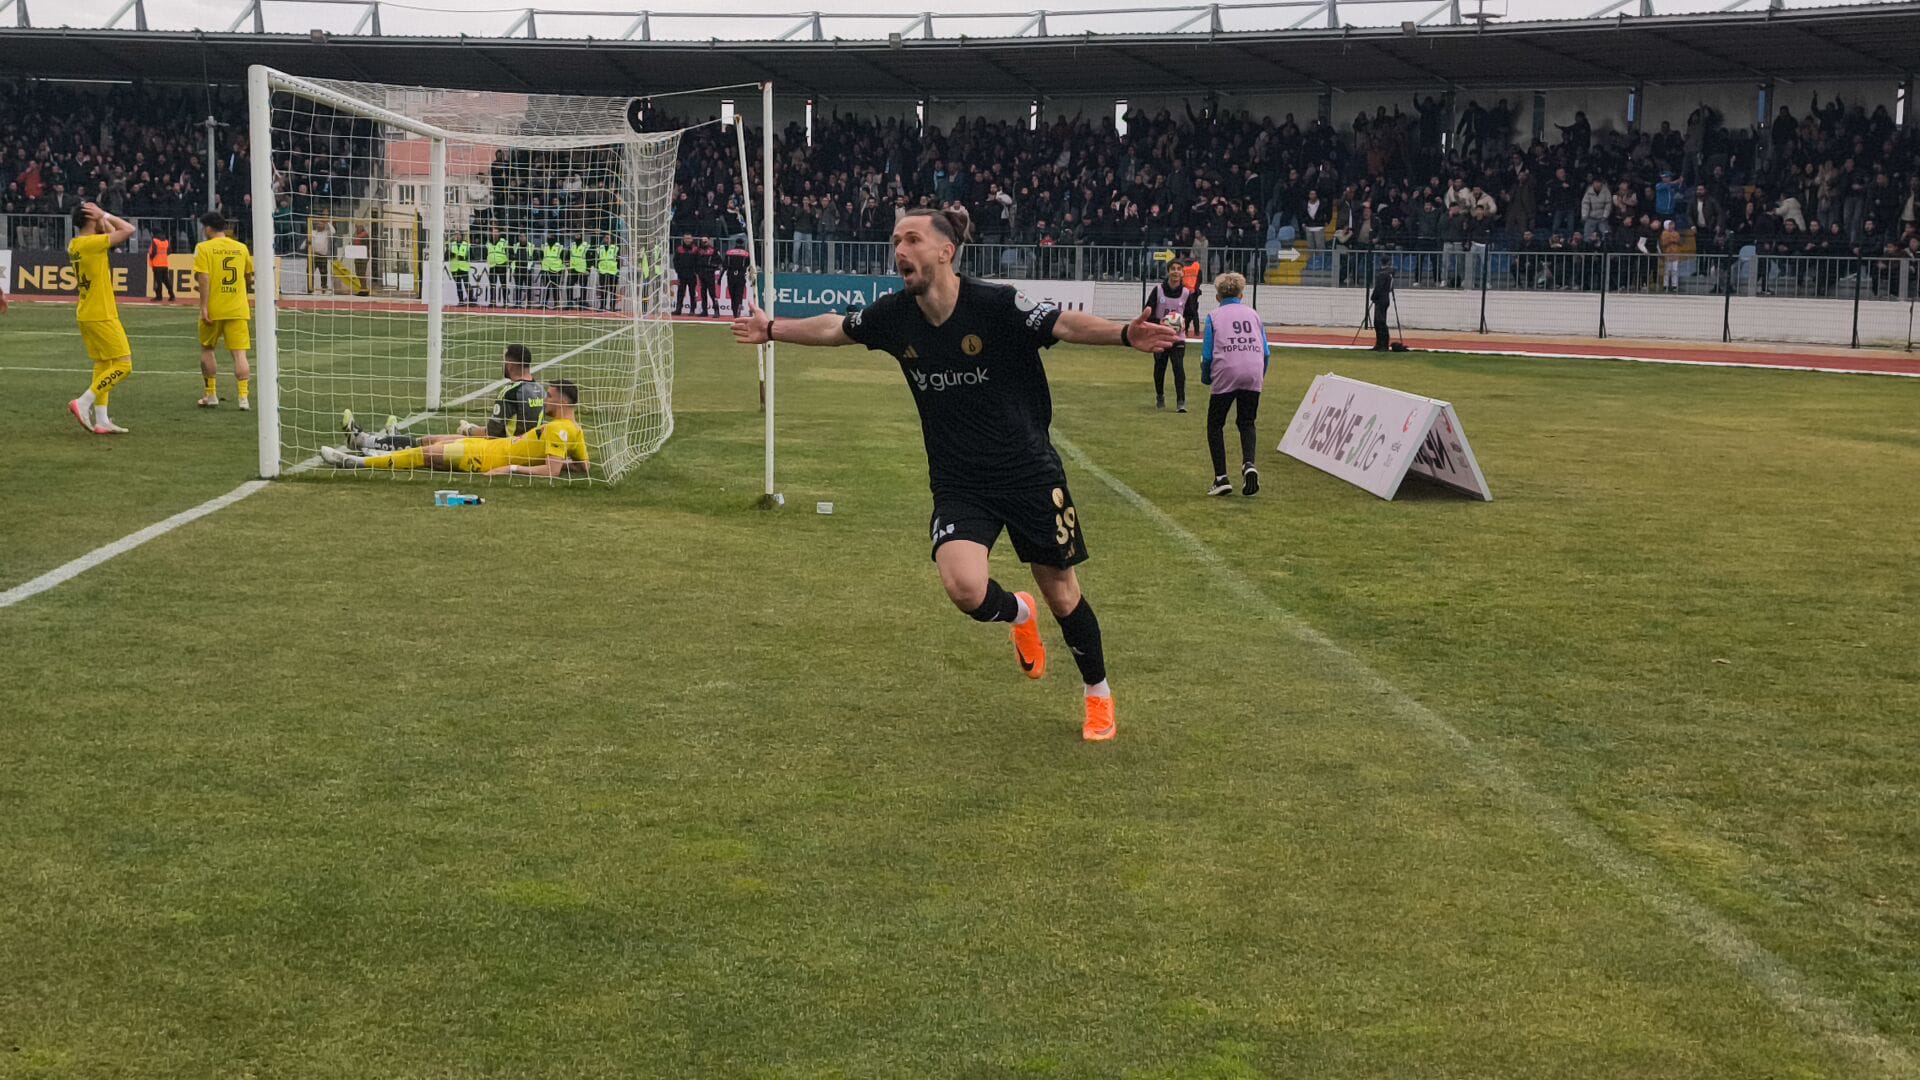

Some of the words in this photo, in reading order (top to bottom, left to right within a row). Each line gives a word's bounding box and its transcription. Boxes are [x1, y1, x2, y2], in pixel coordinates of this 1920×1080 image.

[221, 257, 238, 285] 5
[1232, 320, 1252, 334] 90
[1227, 336, 1256, 345] TOP
[929, 366, 990, 391] gürok
